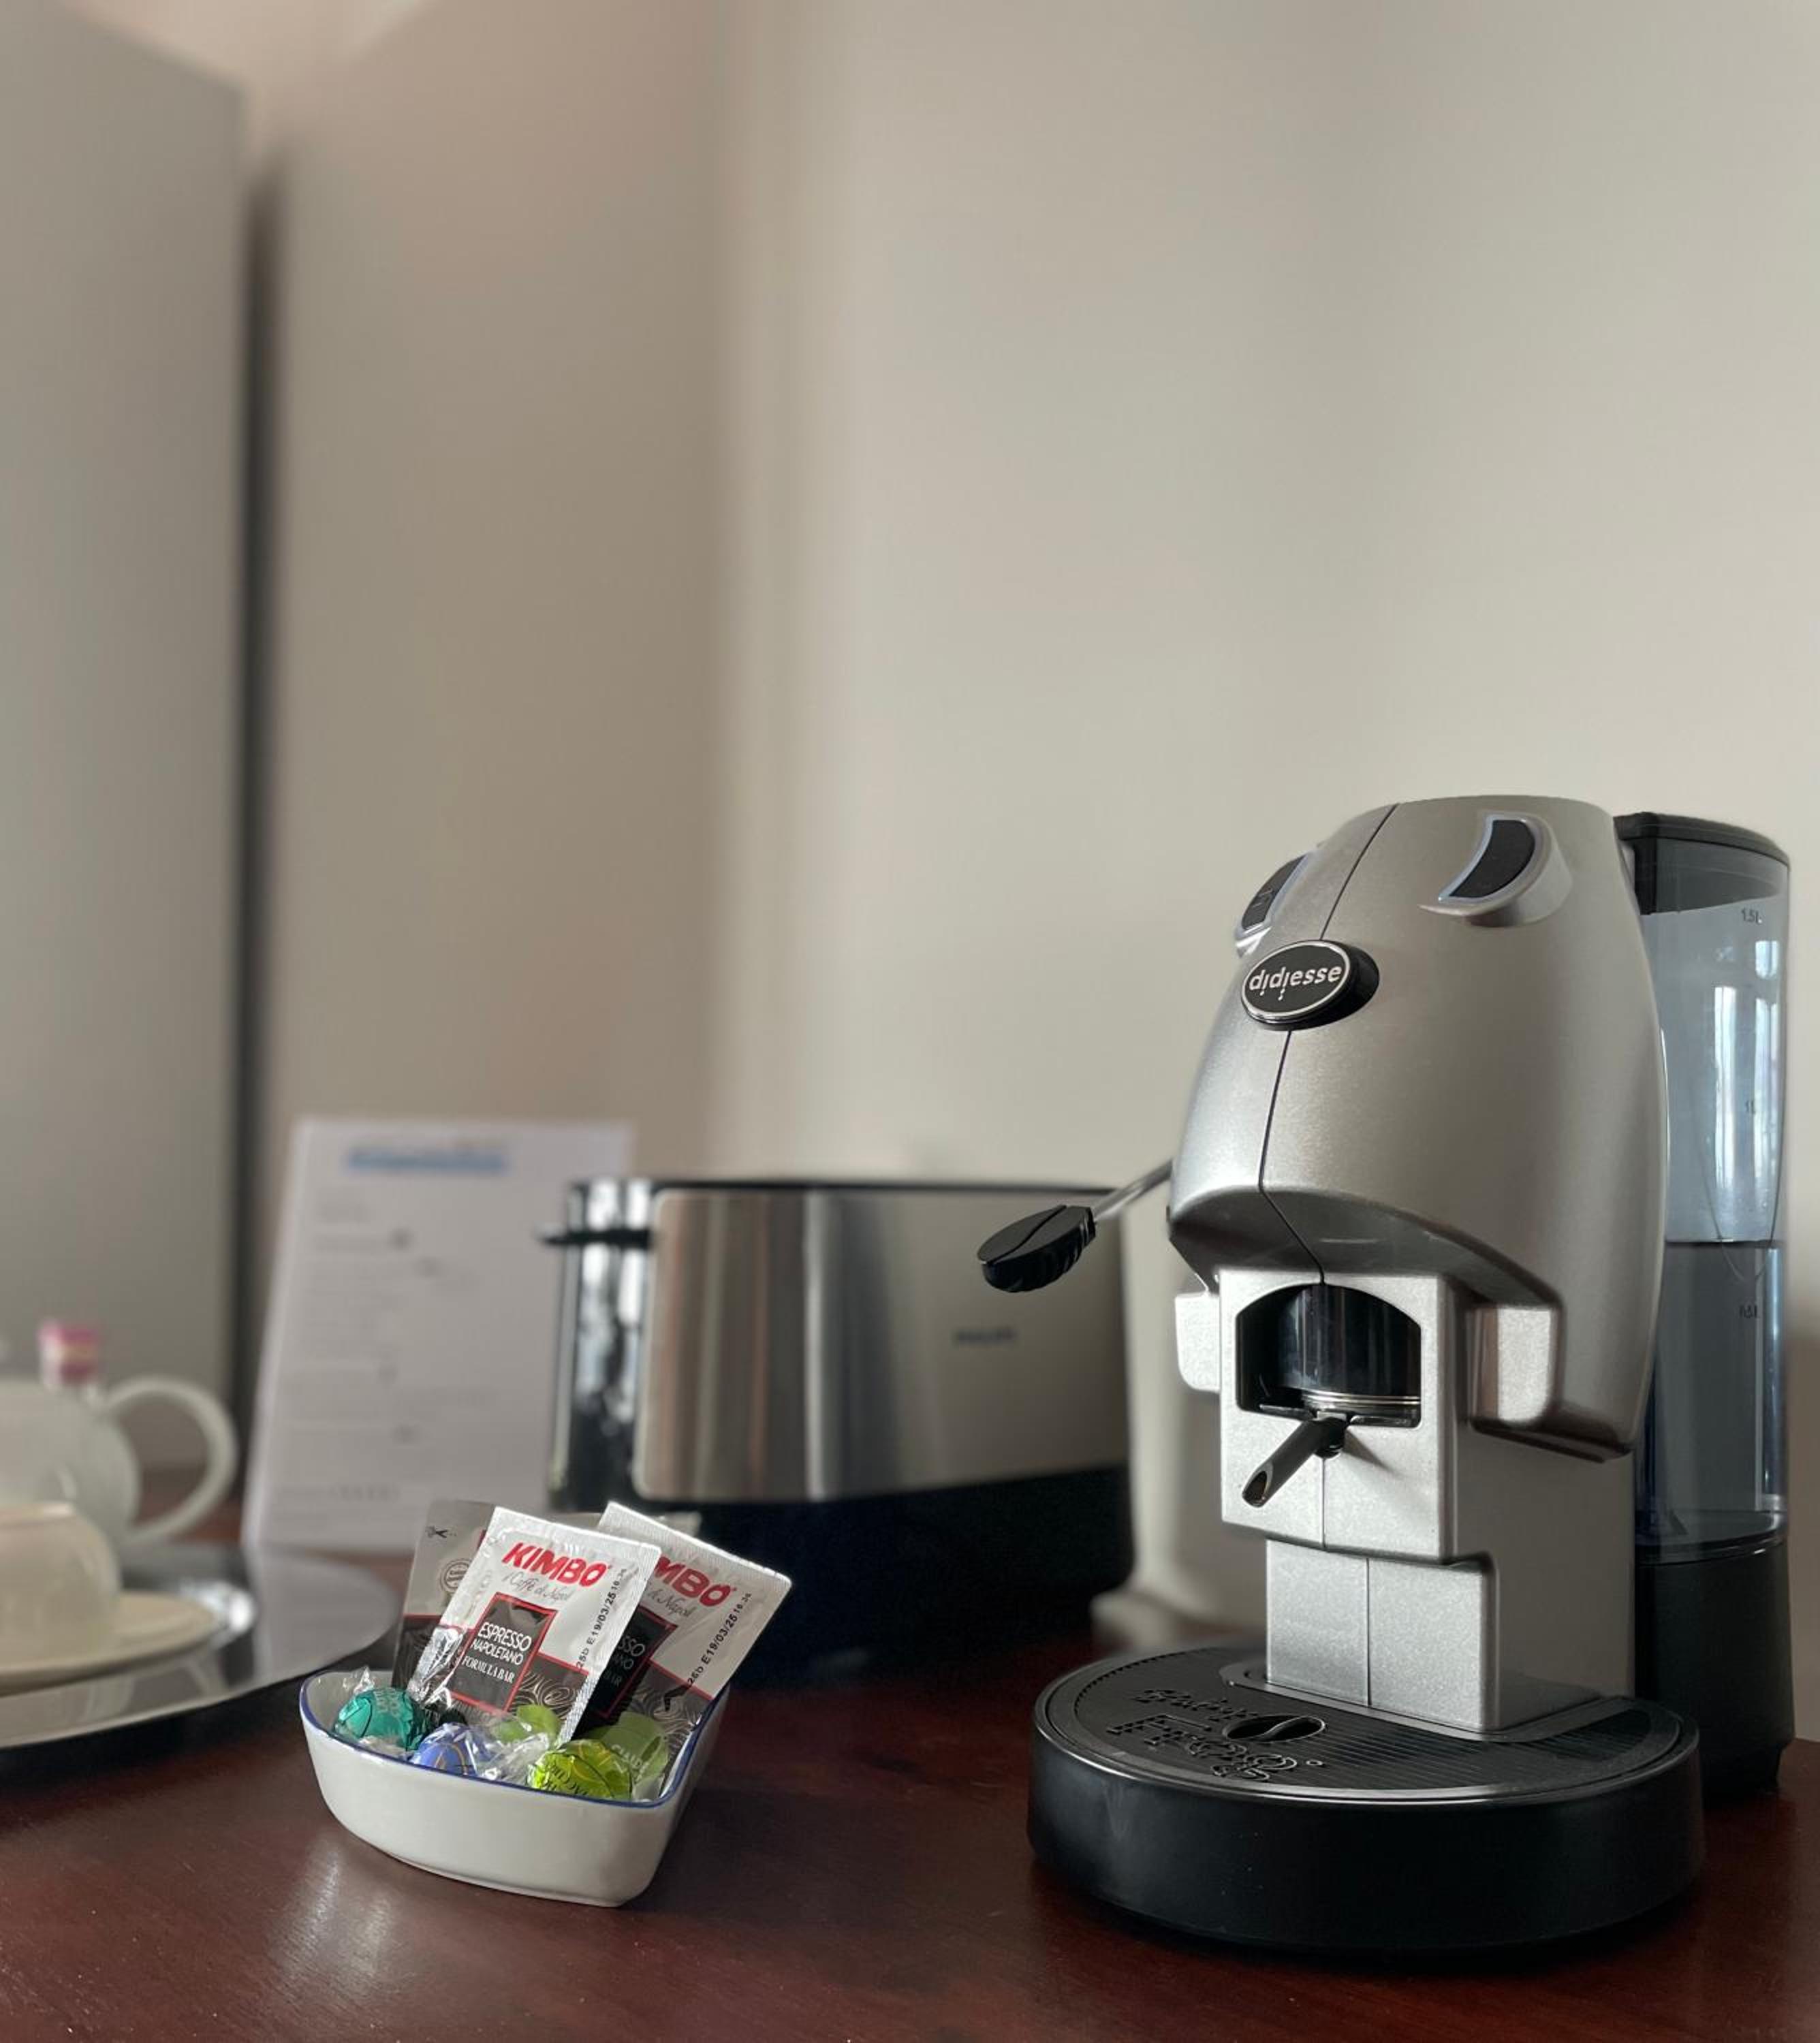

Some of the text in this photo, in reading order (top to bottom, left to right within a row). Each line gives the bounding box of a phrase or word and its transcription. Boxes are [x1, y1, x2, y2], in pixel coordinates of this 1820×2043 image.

[1249, 966, 1342, 998] didiesse
[502, 1542, 608, 1587] KIMBO
[655, 1556, 732, 1606] MBO
[470, 1638, 524, 1665] NAPOLETANO
[477, 1621, 532, 1651] ESPRESSO
